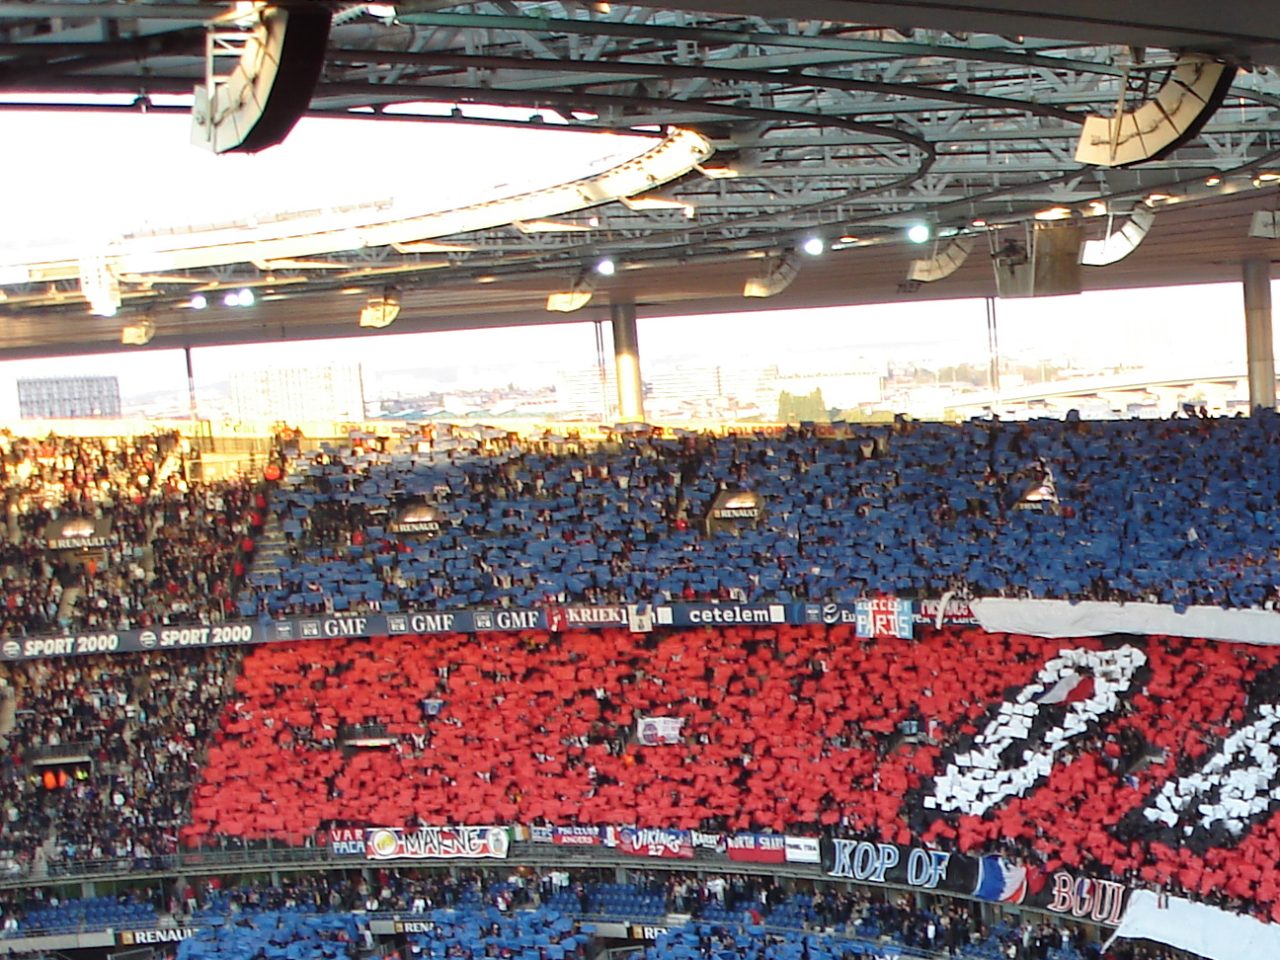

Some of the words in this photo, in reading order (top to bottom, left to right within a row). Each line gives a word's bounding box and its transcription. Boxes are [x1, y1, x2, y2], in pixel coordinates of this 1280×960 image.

[411, 614, 454, 634] GMF
[496, 611, 539, 630] GMF
[690, 606, 770, 624] cetelem
[160, 628, 211, 647] SPORT
[212, 625, 253, 644] 2000
[324, 618, 367, 637] GMF
[24, 637, 75, 657] SPORT
[77, 634, 119, 653] 2000
[332, 828, 364, 841] VAR
[648, 844, 665, 856] 27
[827, 838, 899, 882] KOP
[907, 848, 950, 888] OF
